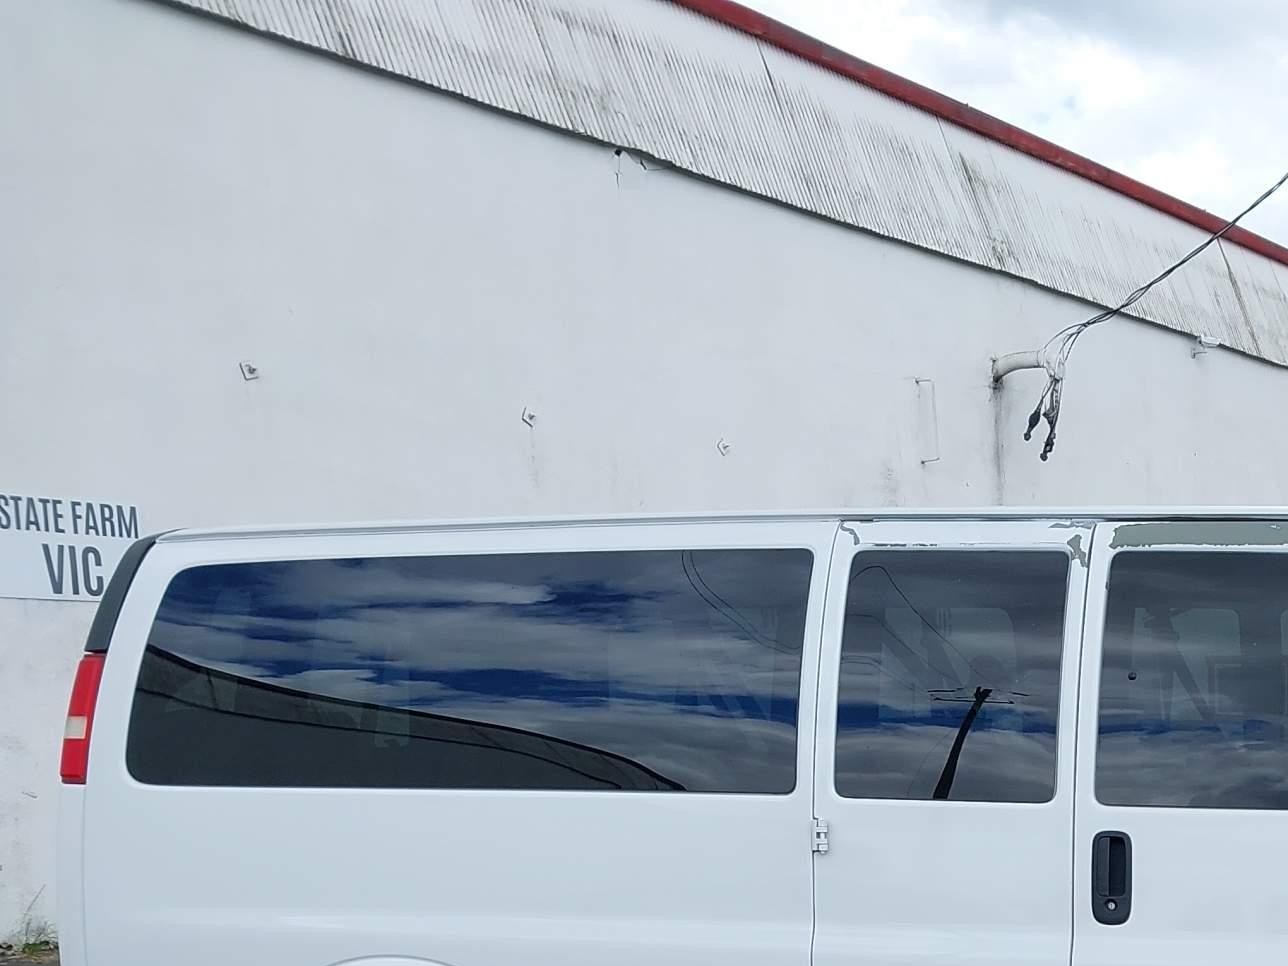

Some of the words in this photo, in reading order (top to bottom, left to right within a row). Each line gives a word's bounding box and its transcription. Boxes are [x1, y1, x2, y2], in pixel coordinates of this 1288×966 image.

[0, 494, 66, 534] STATE
[70, 500, 140, 540] FARM
[41, 543, 105, 598] VIC
